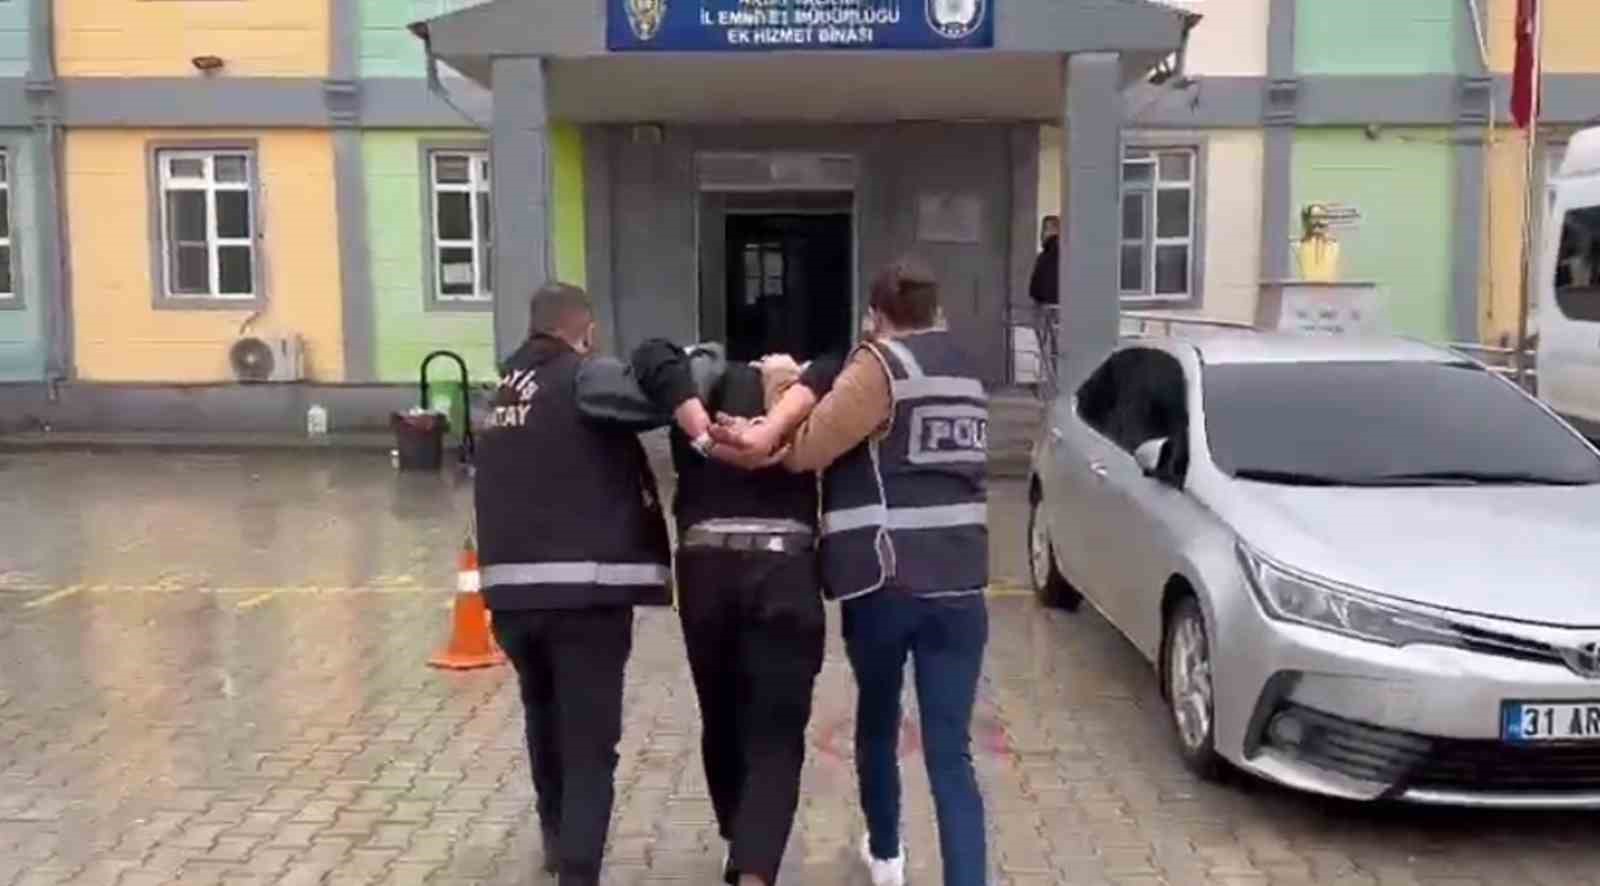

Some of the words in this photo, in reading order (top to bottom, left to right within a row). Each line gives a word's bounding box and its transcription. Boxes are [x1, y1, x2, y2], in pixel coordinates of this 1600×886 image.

[727, 30, 750, 43] EK
[1524, 707, 1554, 735] 31
[1570, 707, 1600, 735] AR
